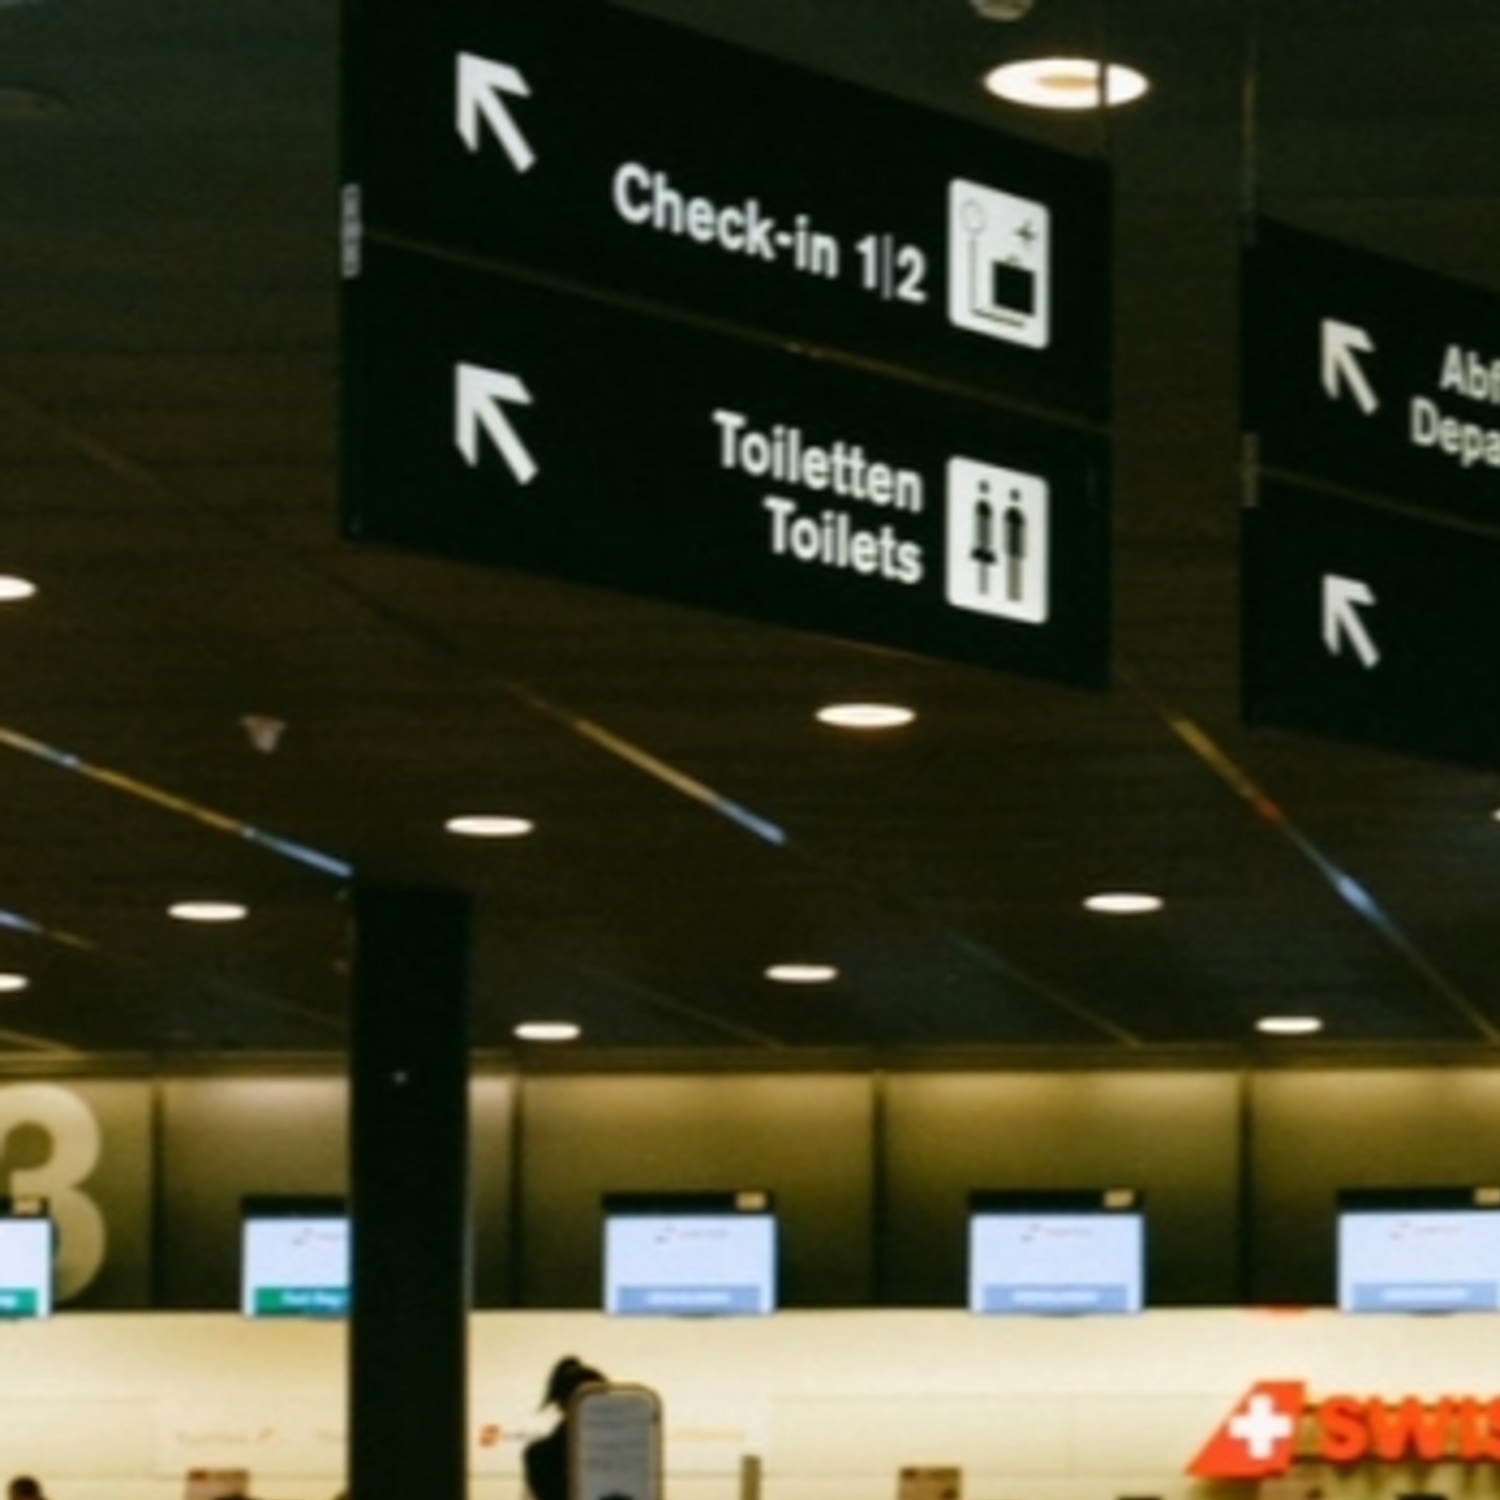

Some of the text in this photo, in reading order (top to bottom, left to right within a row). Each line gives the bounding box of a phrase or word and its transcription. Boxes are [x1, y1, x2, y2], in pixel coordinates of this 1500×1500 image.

[613, 162, 840, 278] Check-in
[712, 409, 924, 513] Toiletten
[763, 495, 925, 585] Toilets
